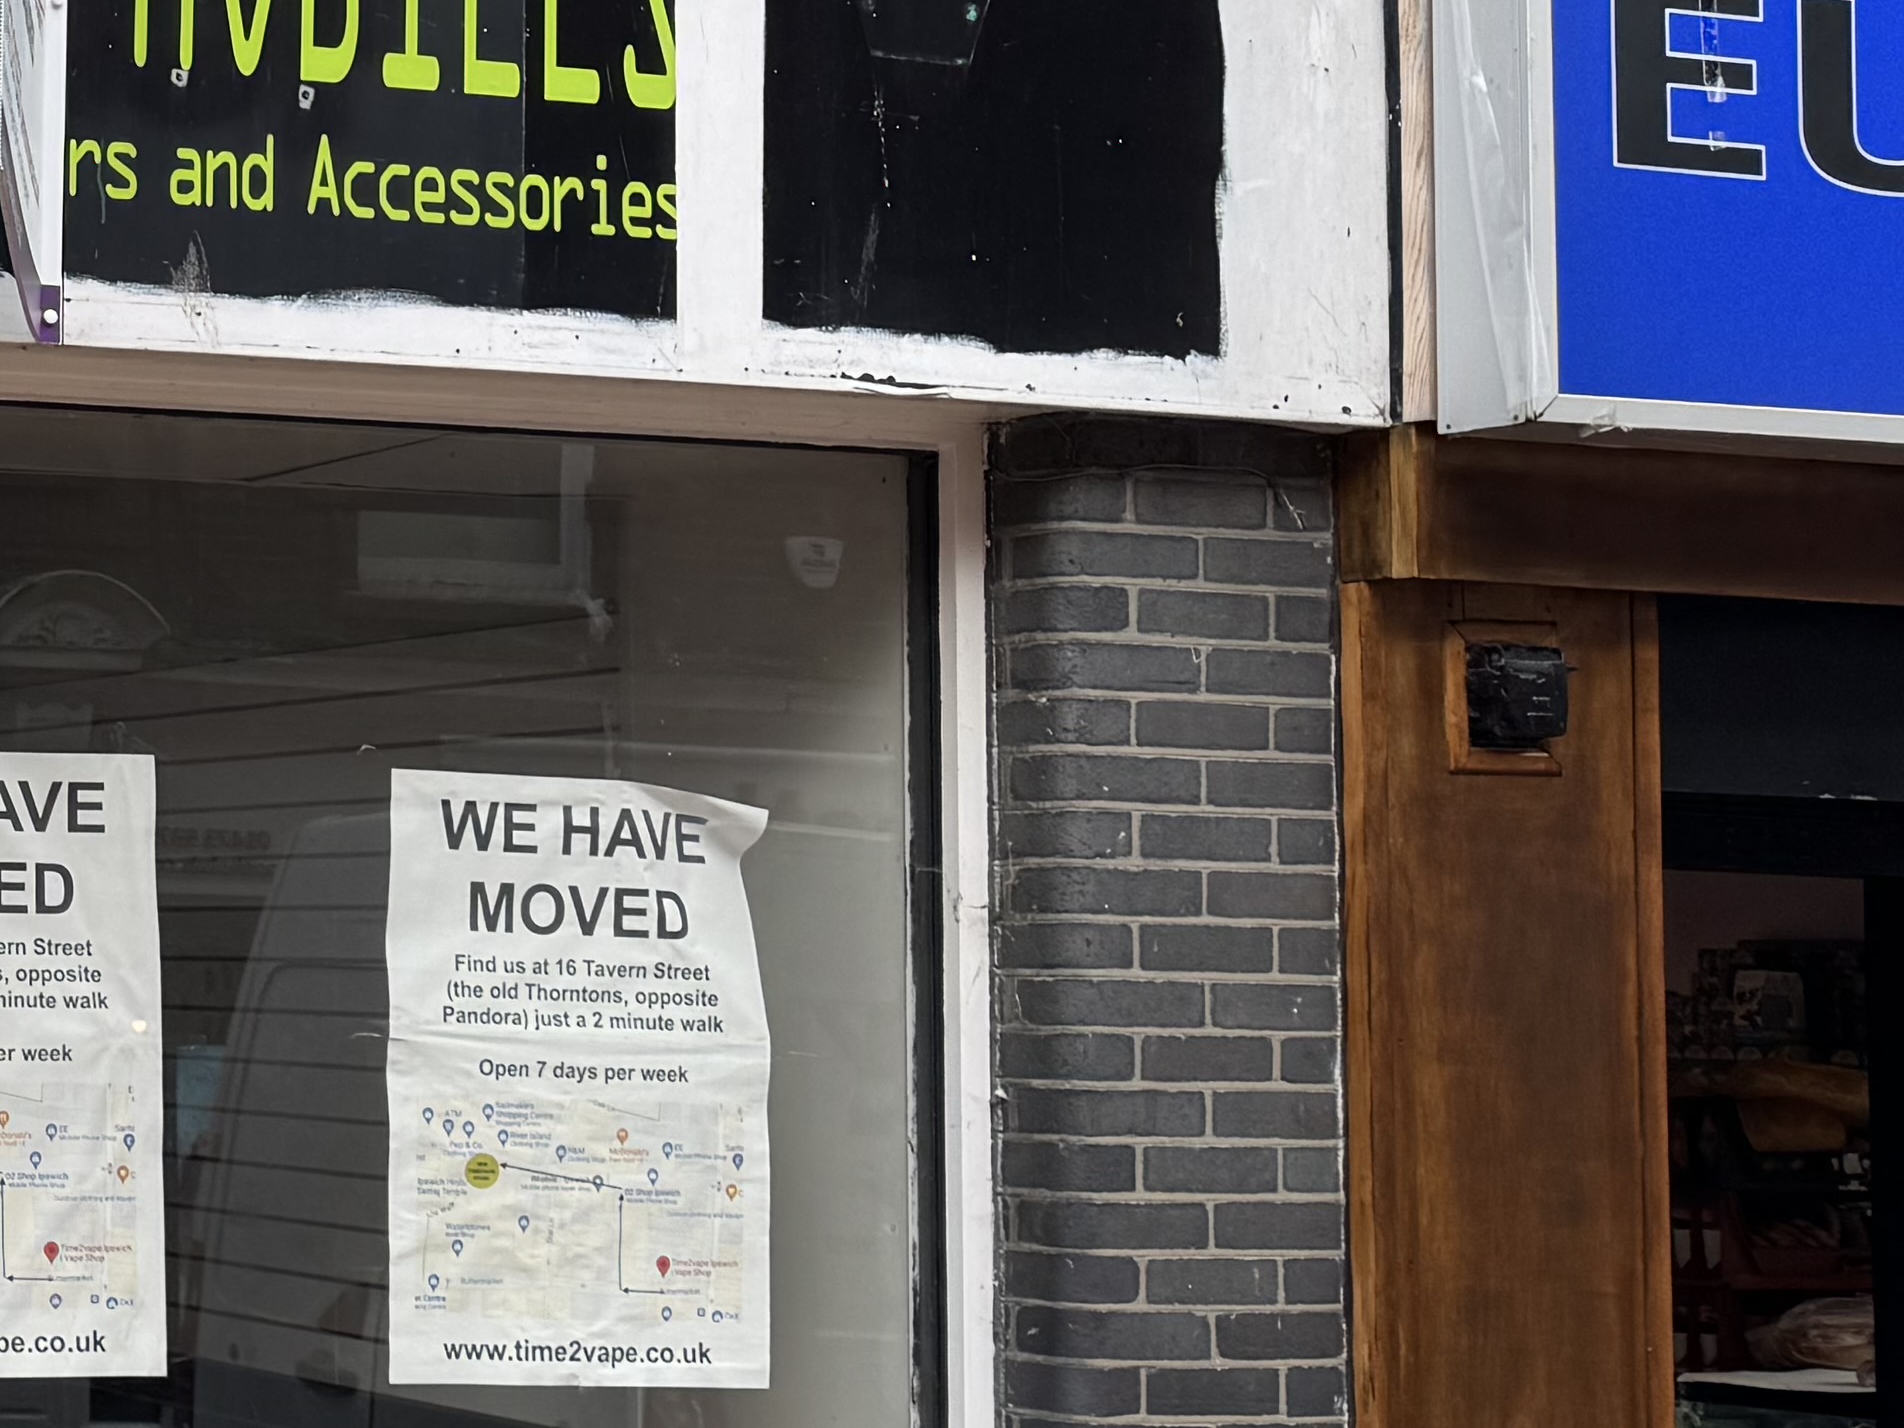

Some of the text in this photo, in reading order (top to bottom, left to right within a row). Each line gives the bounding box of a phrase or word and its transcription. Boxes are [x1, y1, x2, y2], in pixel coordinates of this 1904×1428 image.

[170, 135, 274, 211] and
[308, 134, 677, 239] Accessories
[441, 799, 708, 864] WE HAVE
[470, 881, 688, 939] MOVED
[34, 938, 92, 956] Street
[16, 965, 101, 986] opposite
[455, 954, 710, 981] Find us at 16 Tavern Street
[63, 992, 108, 1009] walk
[447, 980, 718, 1009] (the old Thorntons, opposite
[443, 1006, 723, 1033] Pandora) just a 2 minute walk
[22, 1044, 72, 1061] week
[479, 1059, 688, 1084] Open 7 days per week
[443, 1339, 711, 1368] www.time2vape.co.uk
